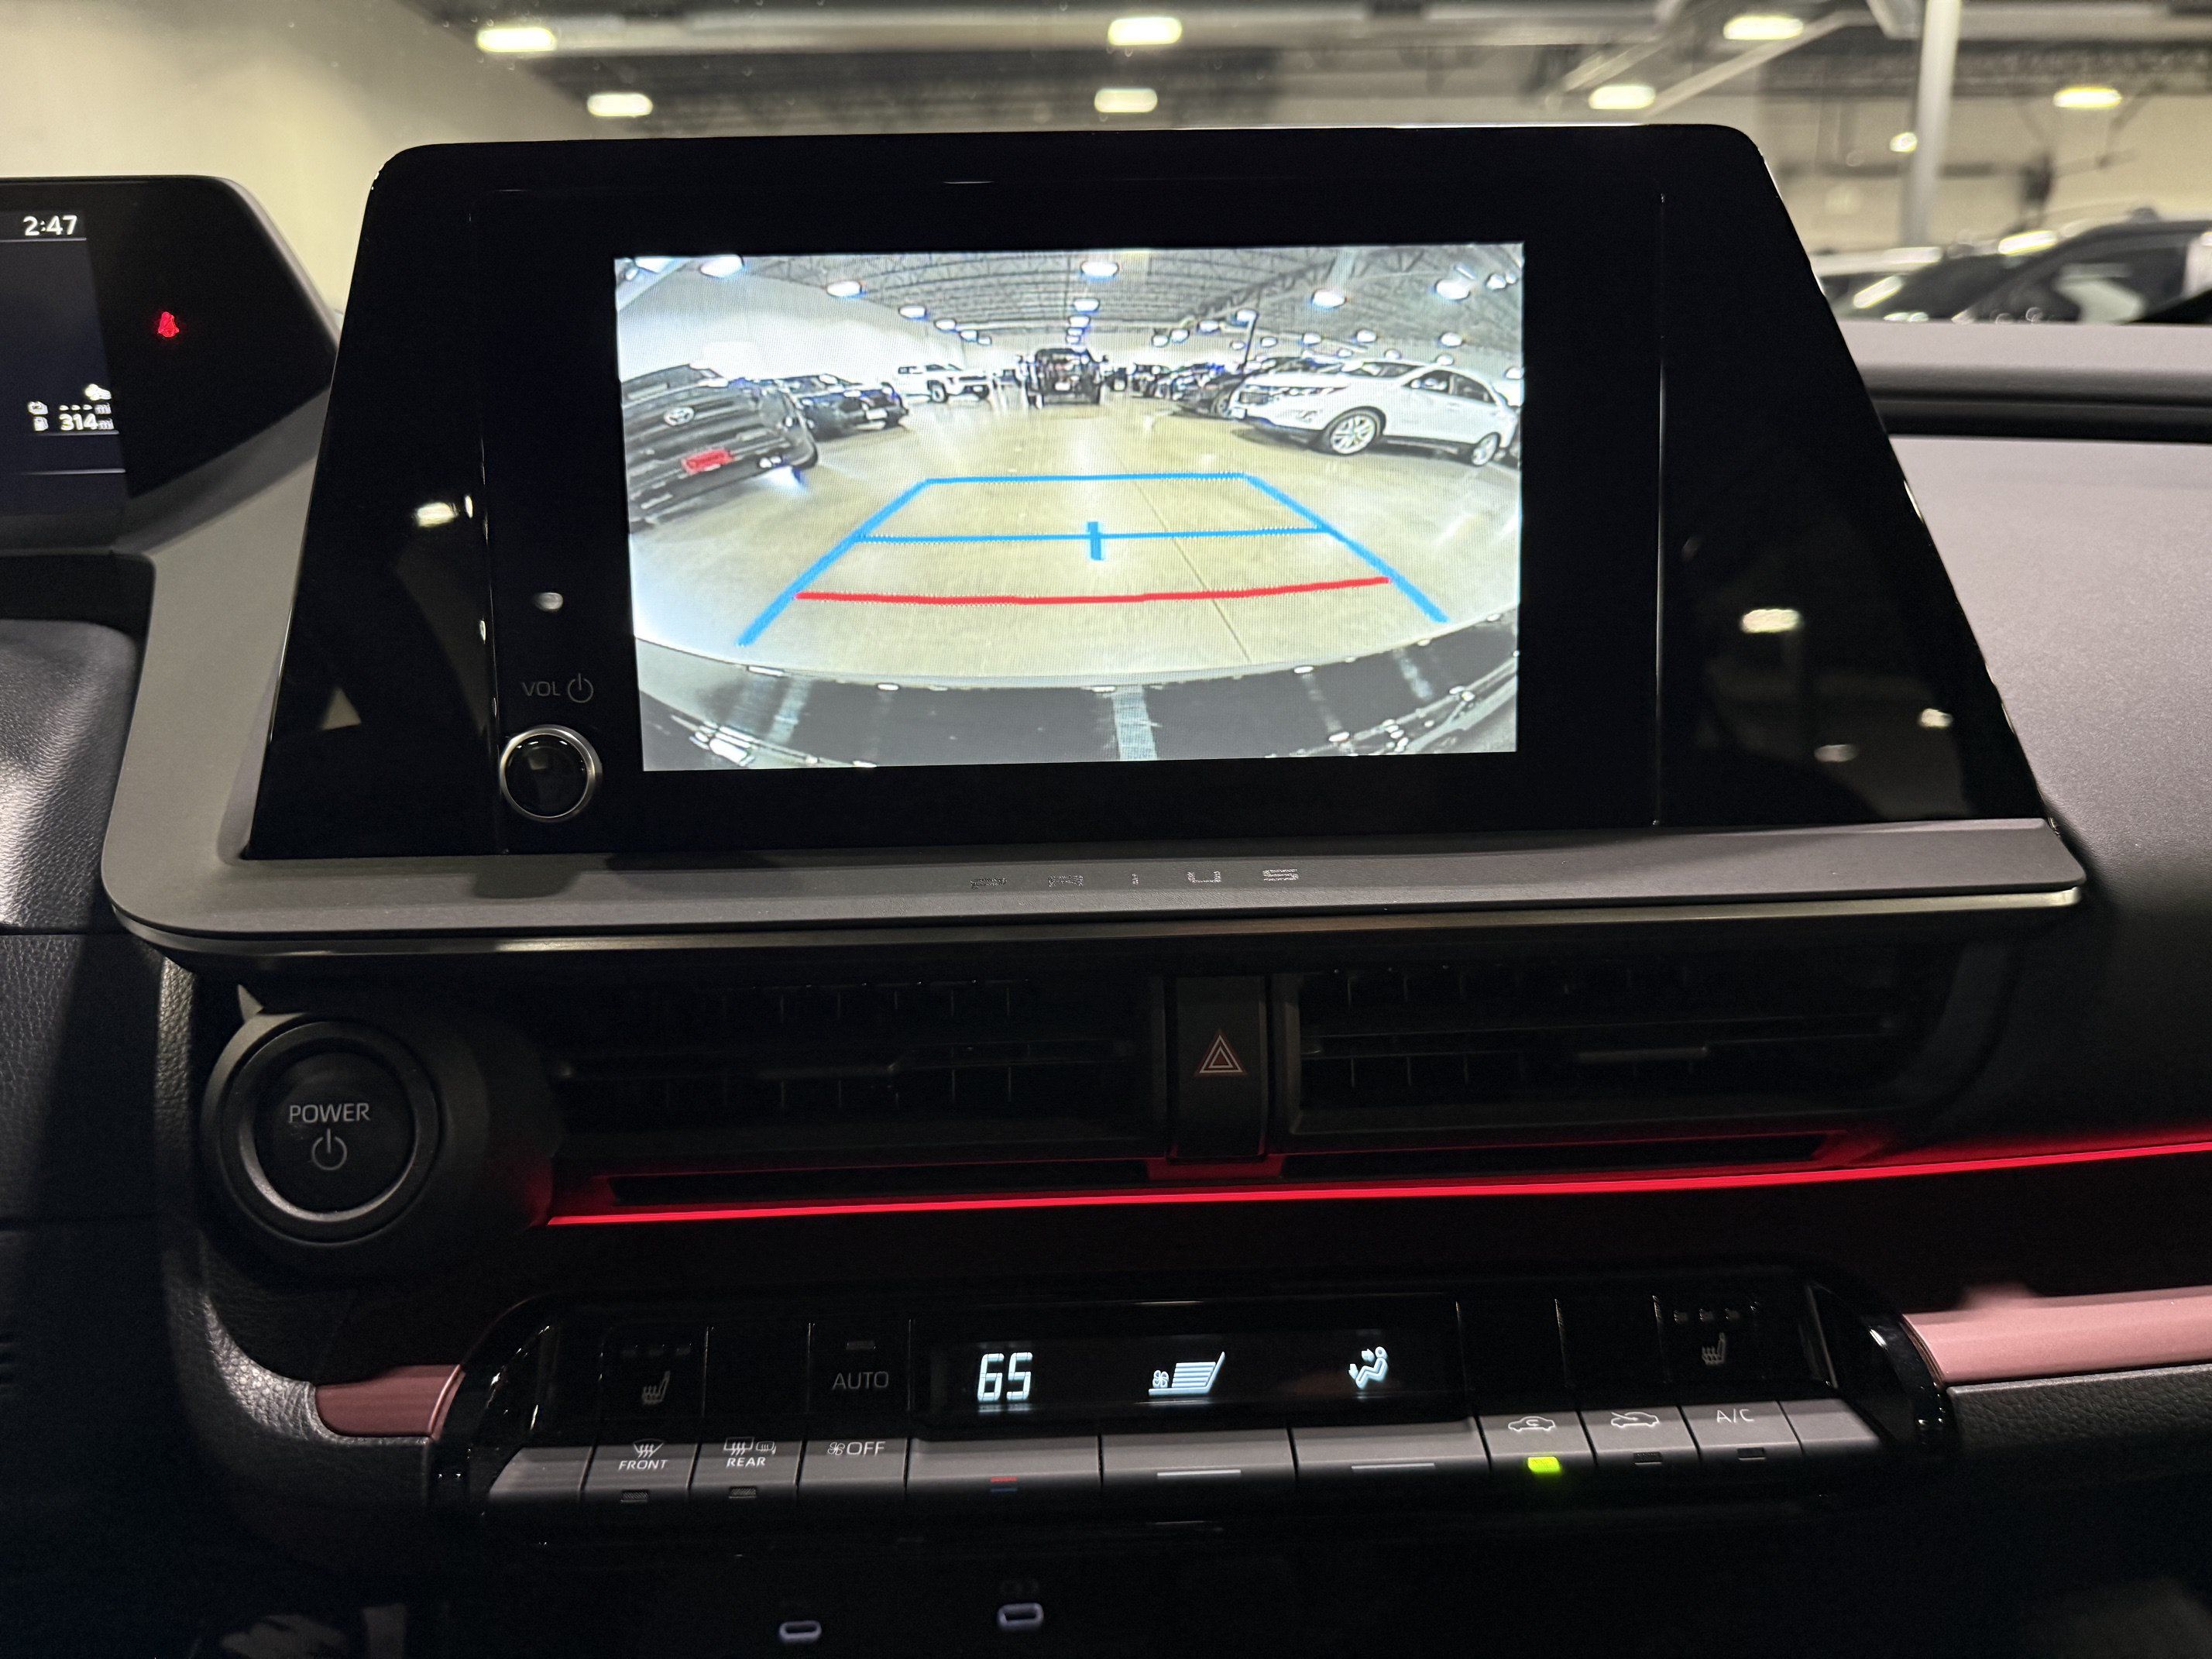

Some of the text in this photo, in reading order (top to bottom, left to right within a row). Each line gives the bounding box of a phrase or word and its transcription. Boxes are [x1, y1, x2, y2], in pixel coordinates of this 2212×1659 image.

[22, 215, 77, 235] 2:47
[522, 681, 561, 696] VOL
[289, 1103, 370, 1123] POWER
[833, 1371, 889, 1390] AUTO
[977, 1352, 1033, 1402] 65
[1716, 1409, 1755, 1424] A/C
[846, 1441, 885, 1456] OFF
[619, 1459, 668, 1470] FRONT
[726, 1457, 766, 1468] REAR
